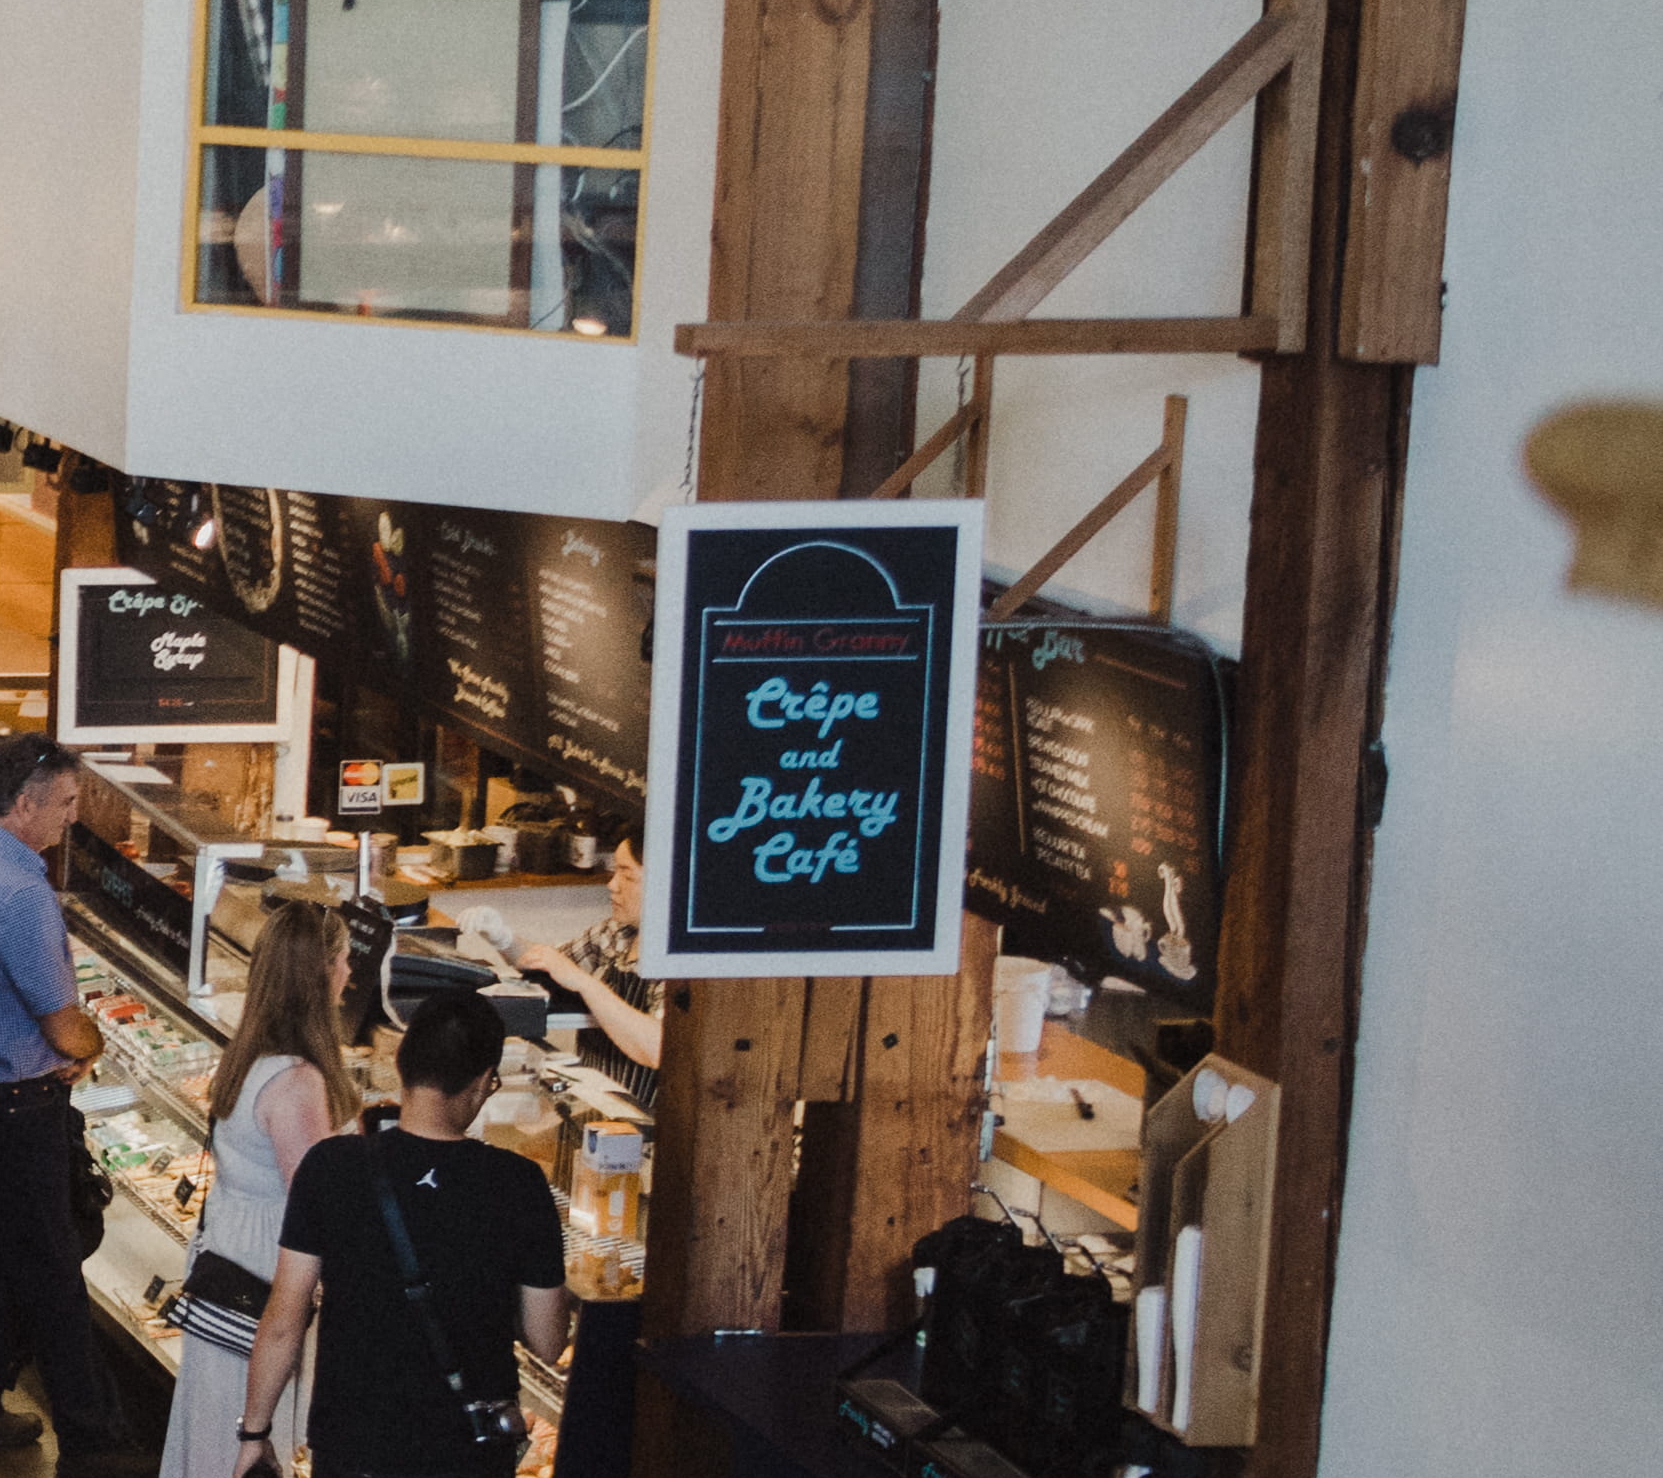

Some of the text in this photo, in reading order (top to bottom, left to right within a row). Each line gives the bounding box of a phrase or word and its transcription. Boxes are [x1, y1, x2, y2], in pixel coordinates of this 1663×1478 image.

[150, 631, 207, 653] Maple
[723, 627, 911, 654] Muffin Granny
[153, 650, 205, 670] Syrup
[745, 676, 879, 739] Crêpe
[778, 737, 843, 769] and
[347, 790, 377, 804] VISA
[707, 775, 900, 843] Bakery
[753, 830, 859, 883] Café
